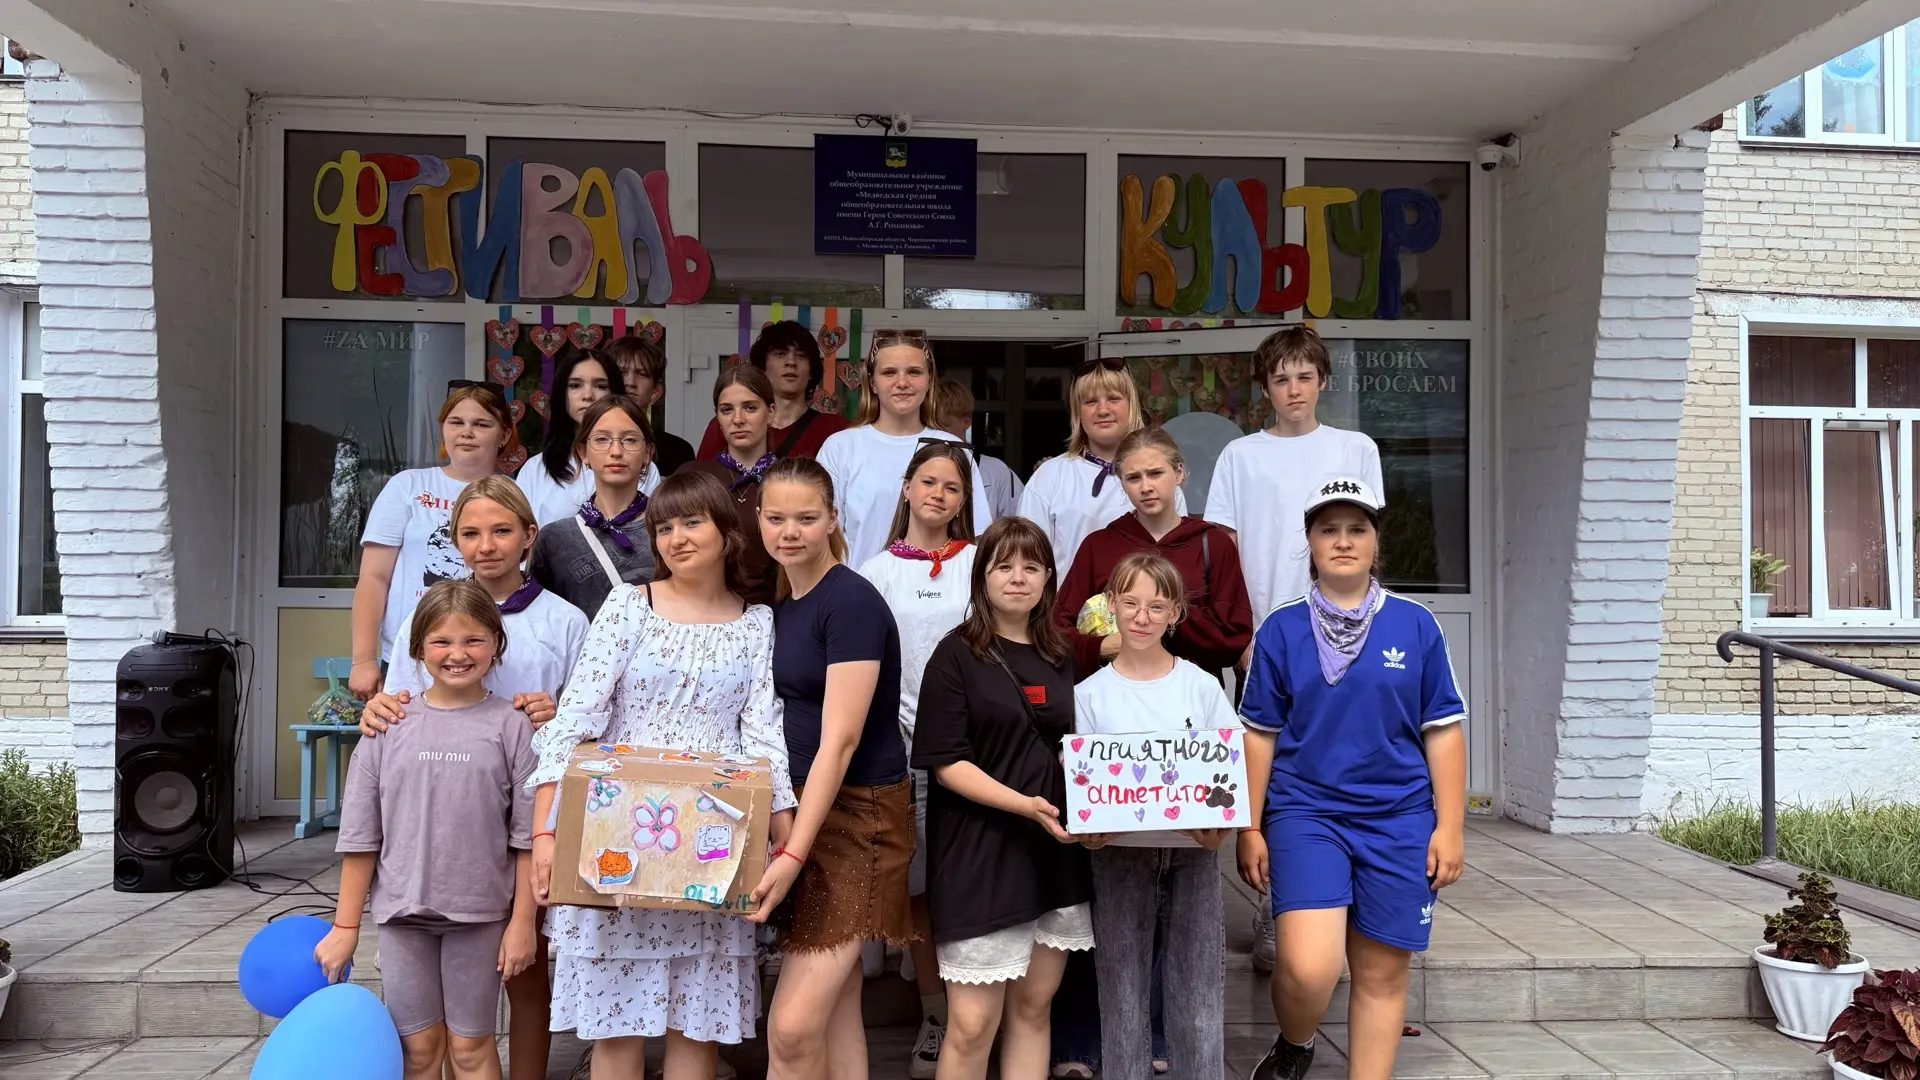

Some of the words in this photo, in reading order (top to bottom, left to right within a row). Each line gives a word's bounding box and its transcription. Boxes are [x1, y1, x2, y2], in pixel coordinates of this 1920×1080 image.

[846, 170, 910, 180] Муниципальное
[829, 181, 914, 191] общеобразовательное
[916, 183, 963, 191] учреждение
[841, 201, 925, 211] общеобразовательная
[863, 212, 886, 220] Героя
[887, 212, 930, 220] Советского
[313, 149, 711, 305] ФЕСТИВАЛЬ
[1120, 172, 1442, 320] КУЛЬТУР
[376, 331, 430, 350] МИР
[1338, 350, 1429, 369] #СВОИХ
[1348, 374, 1456, 393] БРОСАЕМ
[1384, 661, 1406, 669] adidas
